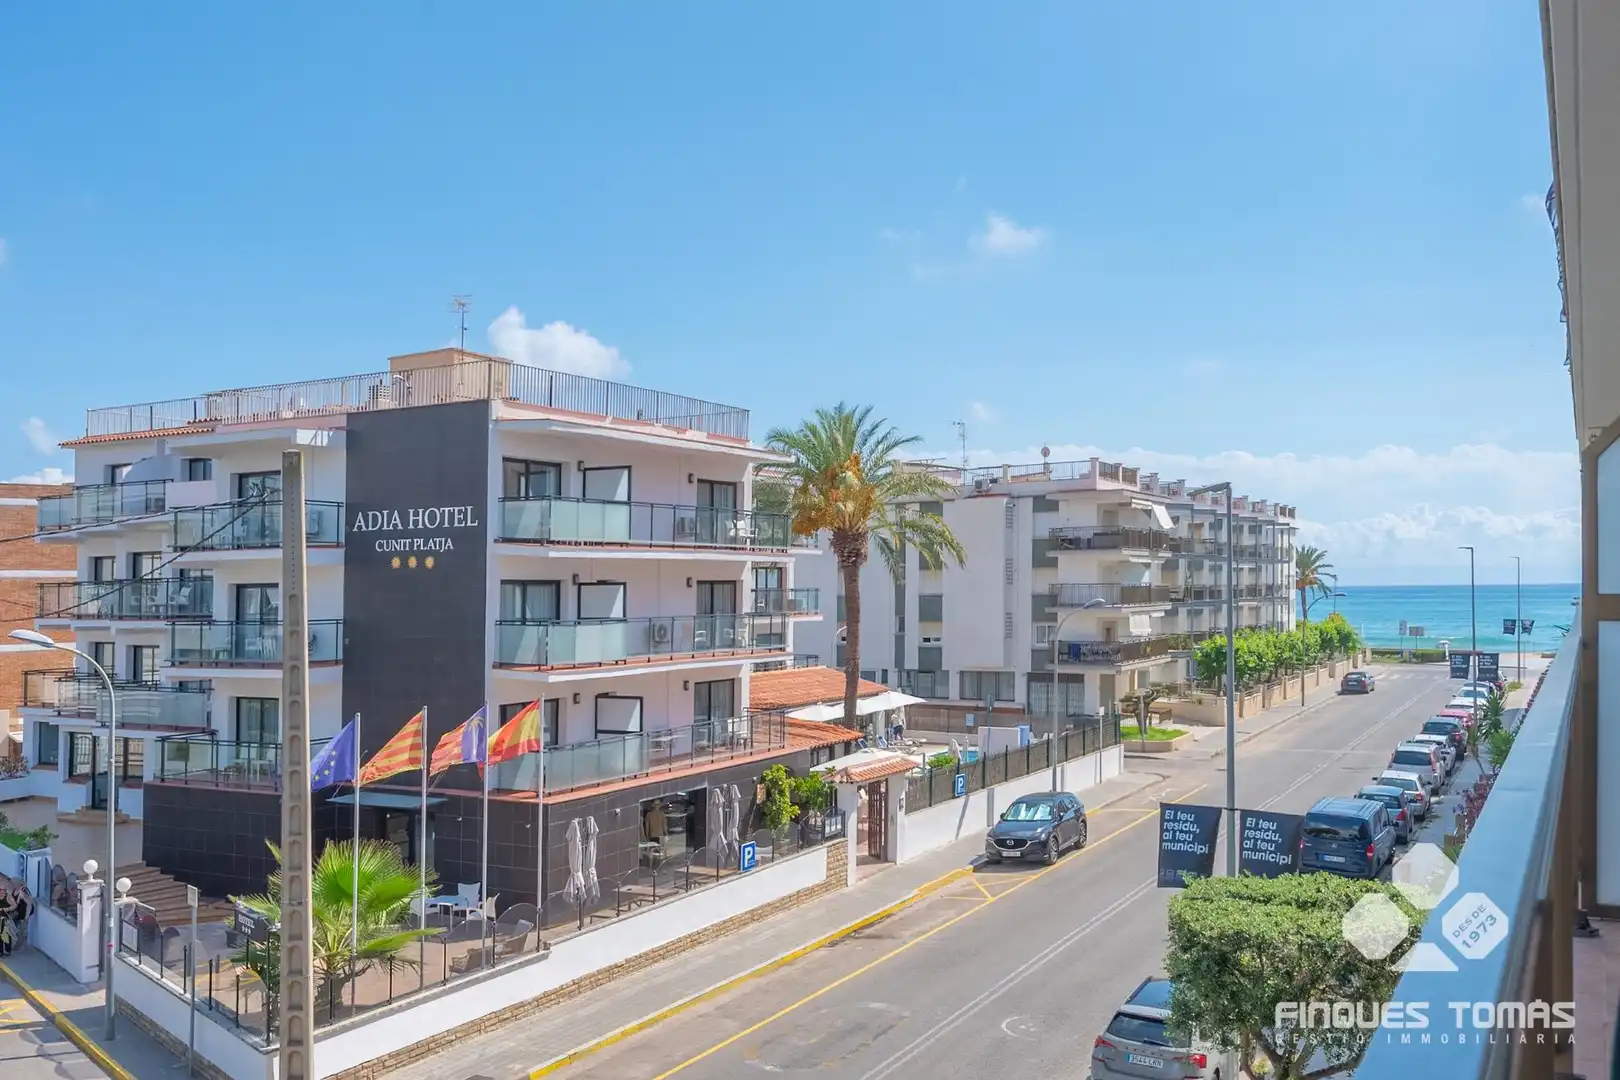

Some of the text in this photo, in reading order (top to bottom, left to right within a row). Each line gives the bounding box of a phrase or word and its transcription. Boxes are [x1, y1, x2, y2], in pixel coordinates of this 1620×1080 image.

[352, 505, 479, 532] ADIA HOTEL
[375, 537, 454, 552] CUNIT PLATJA
[957, 776, 964, 793] P
[1164, 809, 1195, 822] El teu
[1163, 821, 1200, 834] residu,
[1245, 817, 1277, 830] El teu
[1162, 830, 1194, 842] al teu
[1243, 828, 1282, 844] residu,
[1161, 841, 1209, 855] municipi
[1242, 839, 1276, 852] al teu
[744, 846, 753, 868] P
[1242, 850, 1292, 865] municipi
